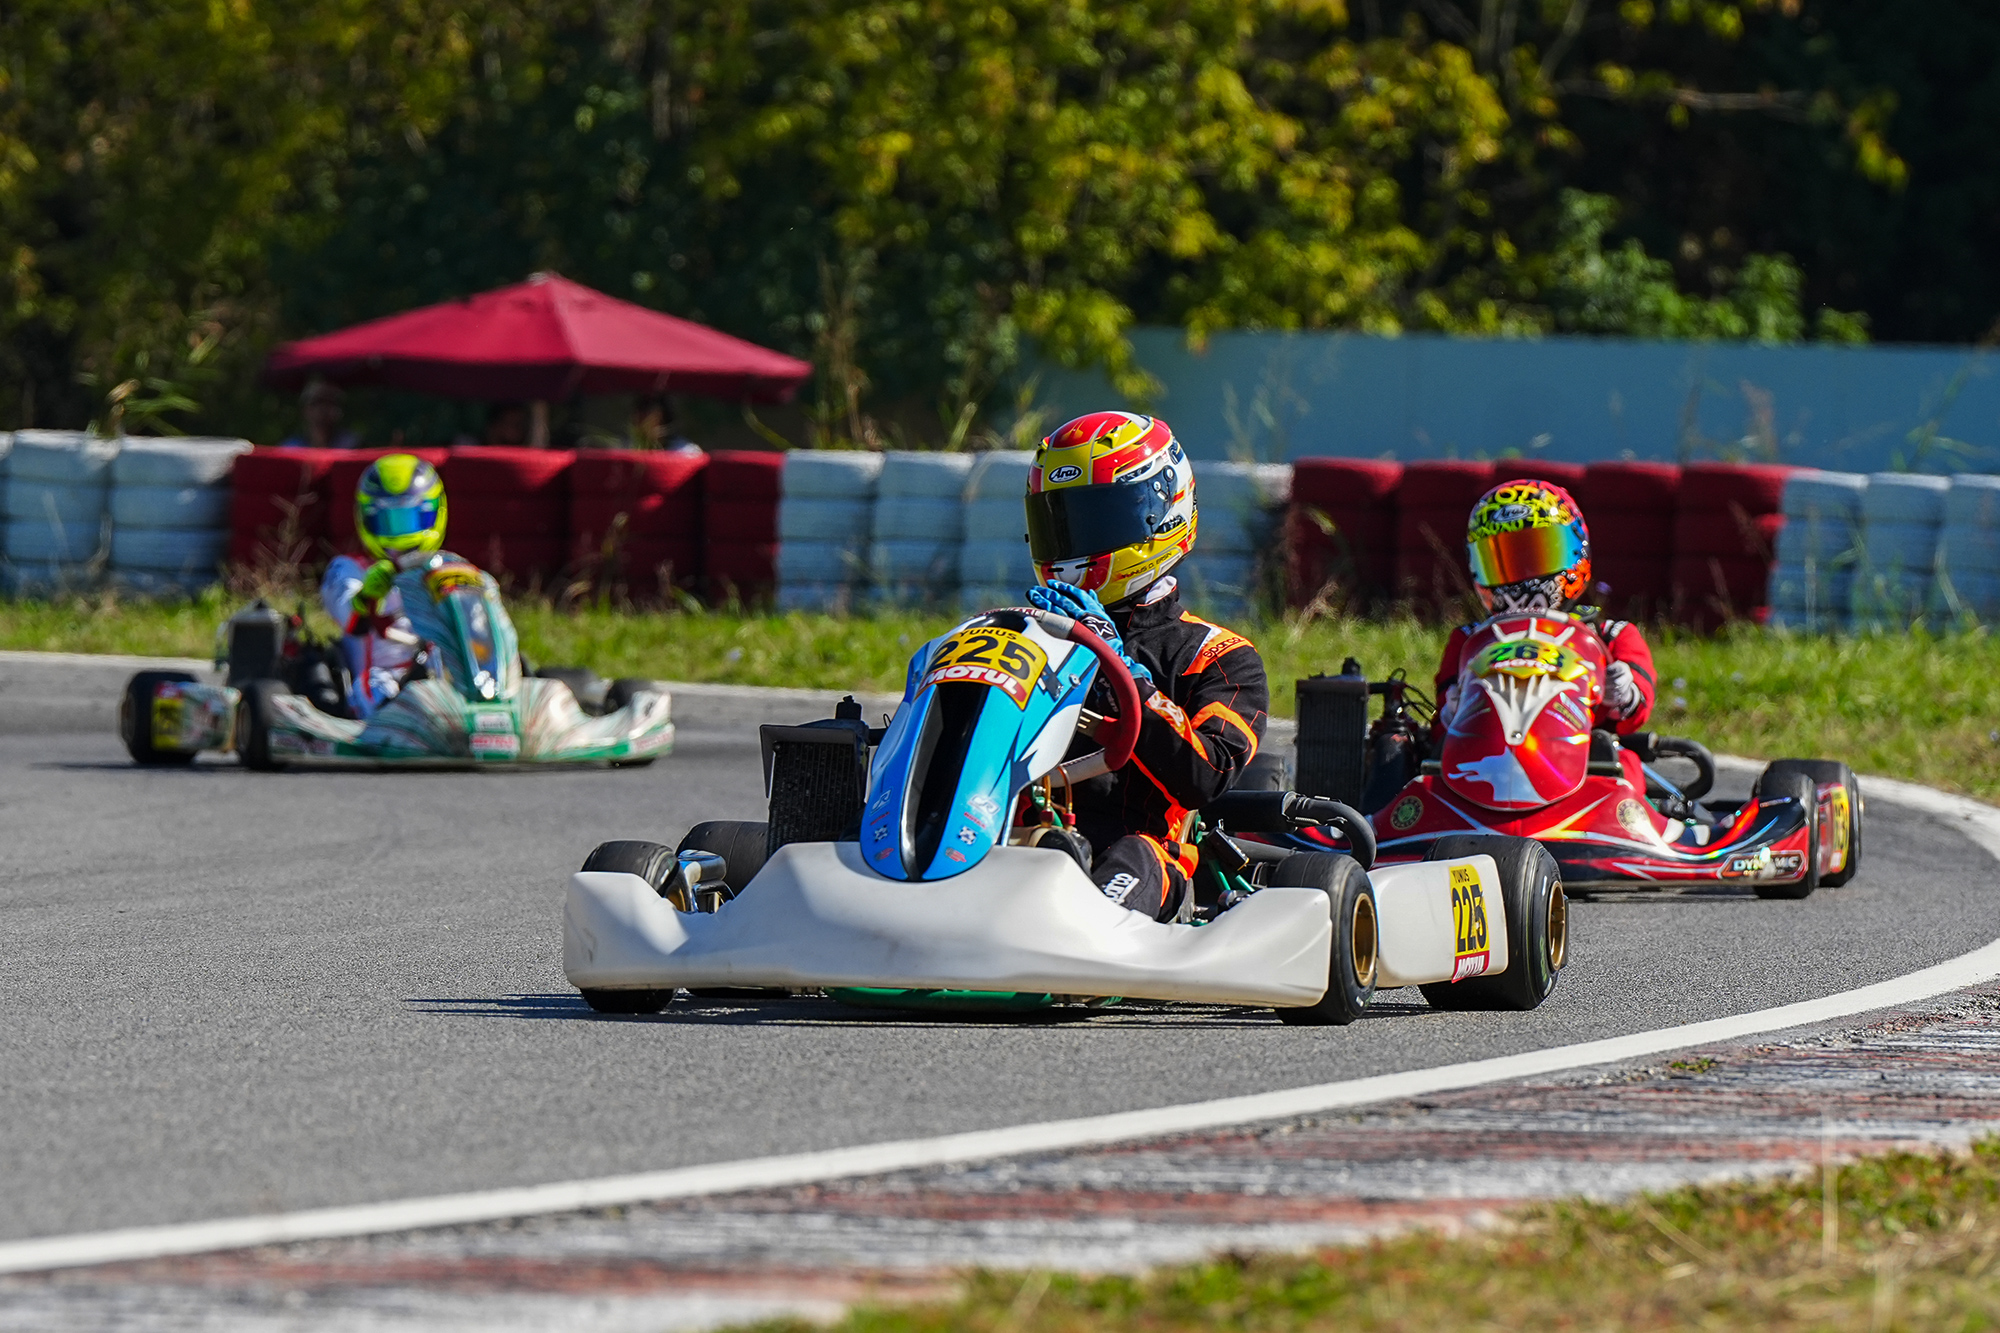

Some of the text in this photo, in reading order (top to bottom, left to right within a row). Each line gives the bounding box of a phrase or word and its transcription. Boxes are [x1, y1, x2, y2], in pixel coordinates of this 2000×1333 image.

[1051, 467, 1078, 480] Arai
[959, 628, 1018, 641] YUNUS
[925, 635, 1037, 681] 225
[1203, 636, 1243, 658] sparco
[922, 665, 1019, 696] MOTUL
[1733, 856, 1800, 872] DYNMIC
[1451, 868, 1470, 884] YUNUS
[1452, 884, 1487, 953] 225
[1453, 955, 1486, 981] MOTUL
